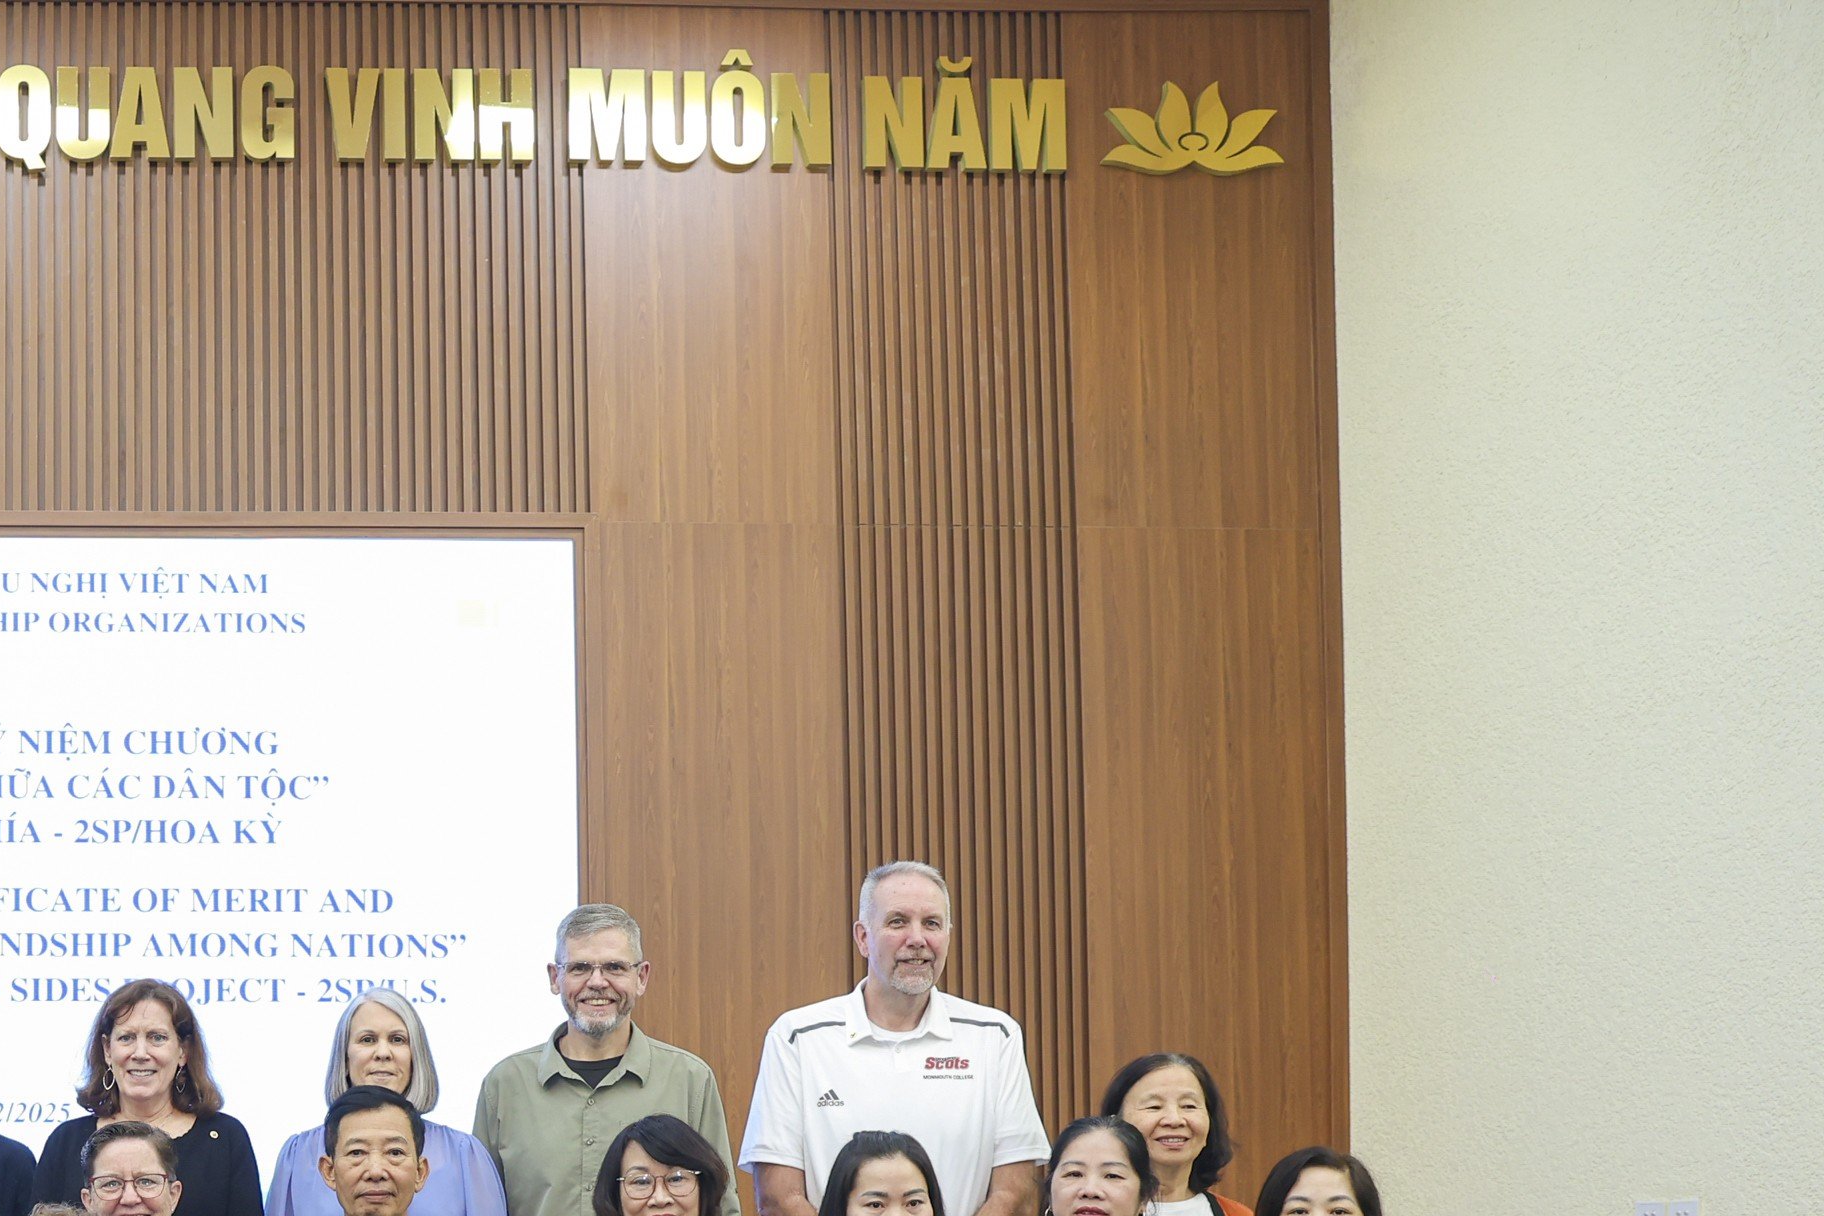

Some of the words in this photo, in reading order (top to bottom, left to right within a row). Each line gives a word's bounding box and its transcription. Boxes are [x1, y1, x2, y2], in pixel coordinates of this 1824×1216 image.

[324, 67, 535, 164] VINH
[568, 48, 831, 168] MUÔN
[862, 55, 1067, 174] NĂM
[31, 572, 109, 599] NGHỊ
[118, 566, 190, 599] VIỆT
[199, 573, 269, 594] NAM
[48, 611, 307, 634] ORGANIZATIONS
[19, 722, 112, 762] NIỆM
[123, 727, 279, 756] CHƯƠNG
[66, 766, 142, 800] CÁC
[152, 767, 226, 800] DÂN
[74, 818, 220, 846] 2SP/HOA
[233, 813, 283, 846] KỲ
[132, 886, 182, 913] OF
[192, 887, 308, 913] MERIT
[320, 888, 394, 914] AND
[142, 932, 279, 958] AMONG
[11, 977, 111, 1003] SIDES
[924, 1056, 970, 1070] Scots
